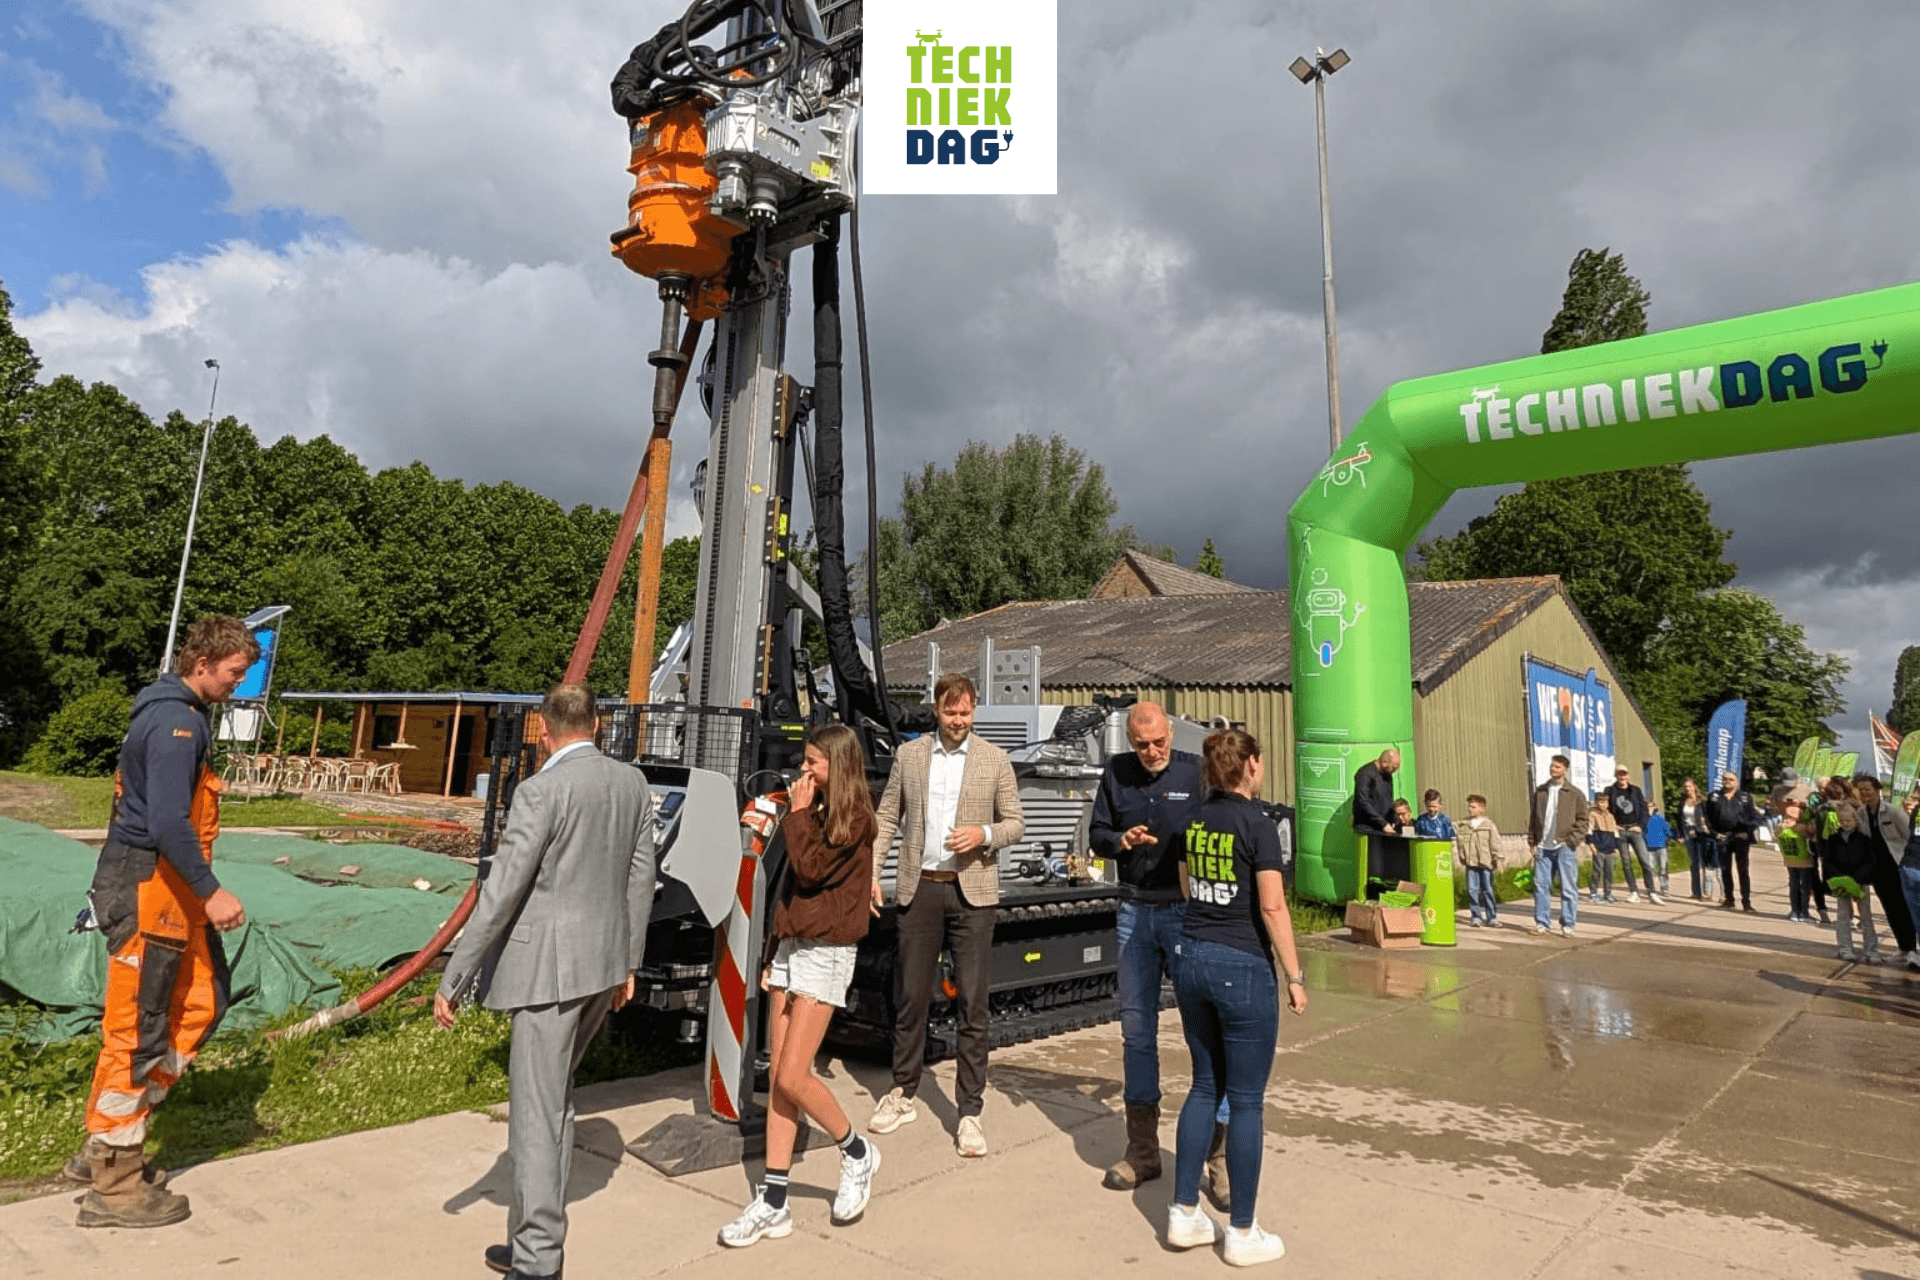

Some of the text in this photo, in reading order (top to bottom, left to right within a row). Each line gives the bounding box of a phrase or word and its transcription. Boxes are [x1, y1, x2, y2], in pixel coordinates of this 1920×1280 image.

[1536, 682, 1560, 725] WE
[1186, 829, 1235, 857] TECH
[1186, 852, 1237, 882] NIEK
[1189, 875, 1231, 906] DAG
